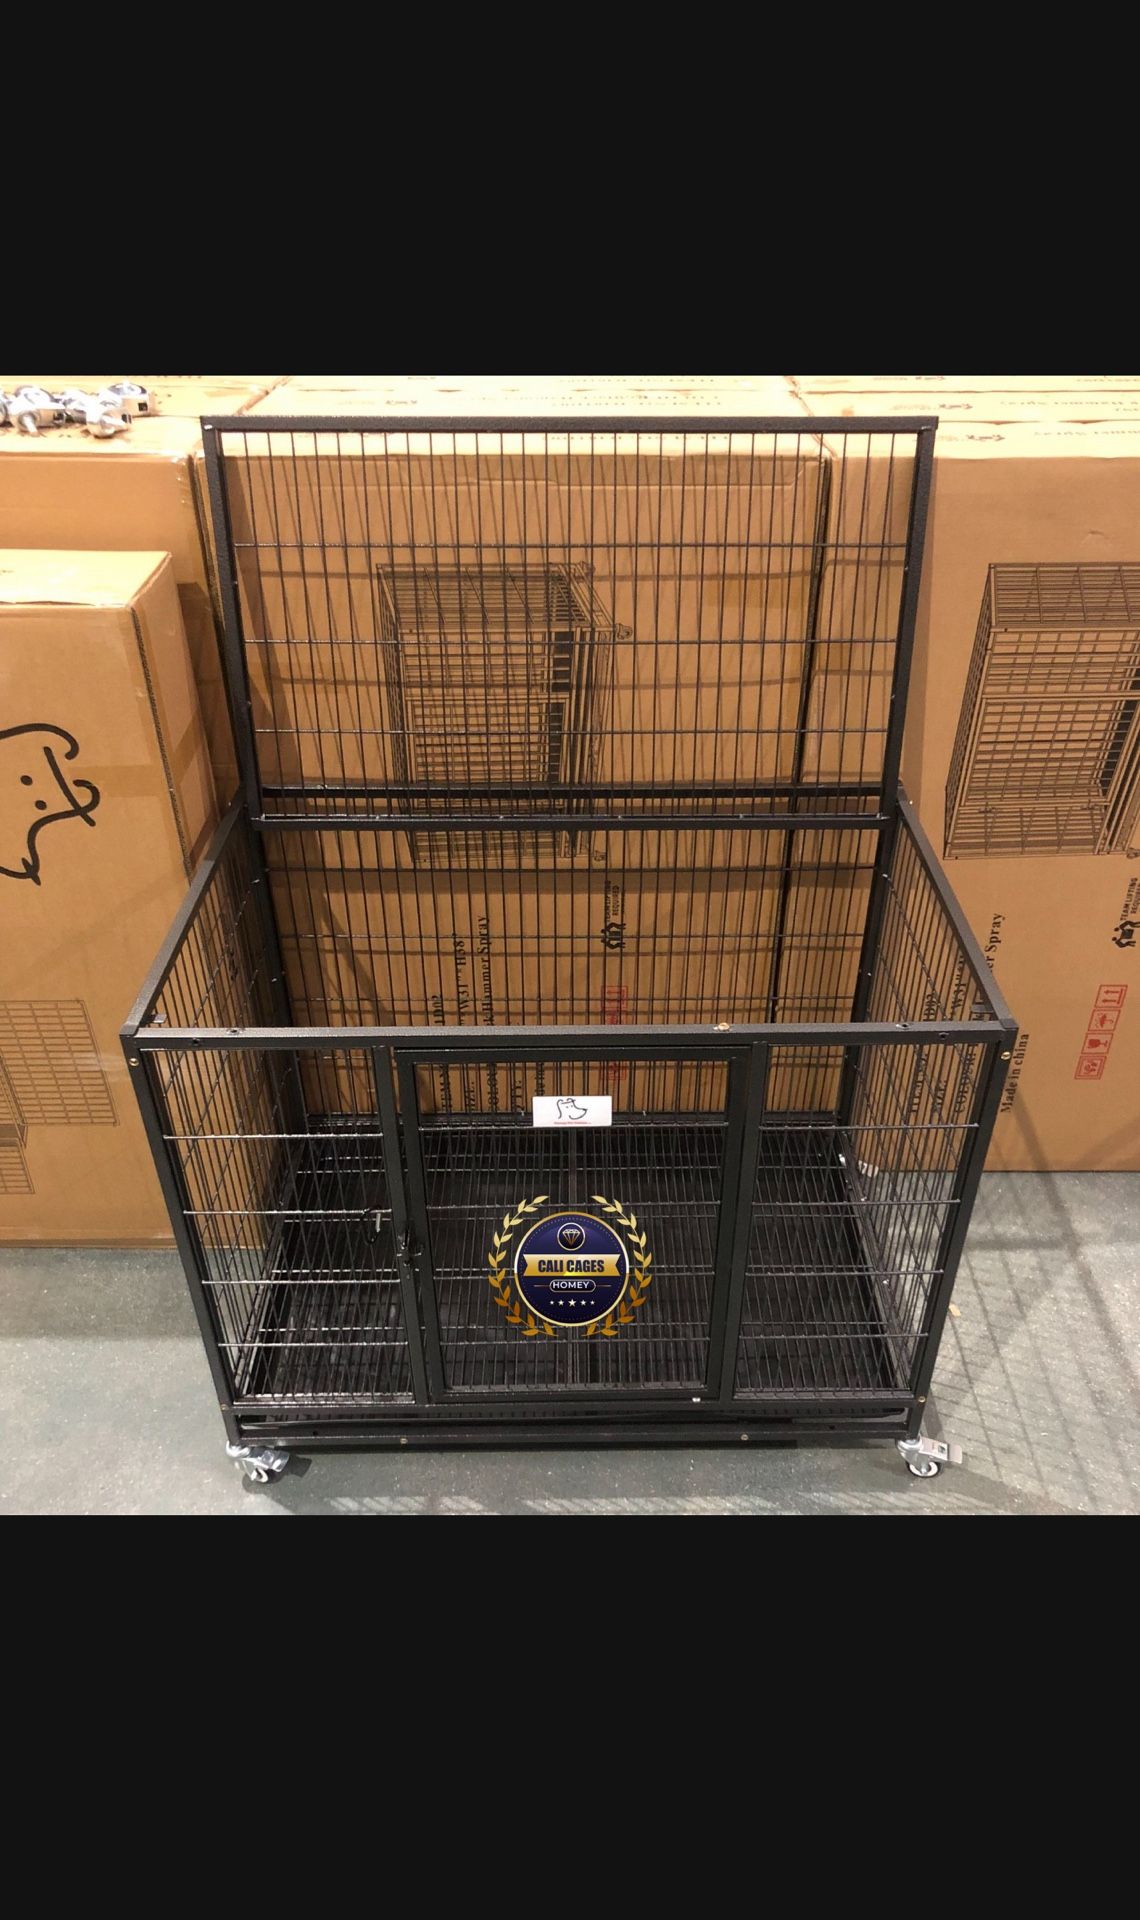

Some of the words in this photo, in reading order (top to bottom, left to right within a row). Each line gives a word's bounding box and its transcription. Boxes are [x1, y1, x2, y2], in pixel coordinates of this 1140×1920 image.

[1119, 903, 1131, 921] TEAM
[1125, 877, 1138, 903] LIFTING
[476, 914, 492, 955] Spray
[984, 913, 1006, 952] Spray
[480, 957, 494, 1012] Hammer
[1013, 1034, 1030, 1066] china
[1010, 1069, 1021, 1080] in
[1000, 1082, 1019, 1113] Made
